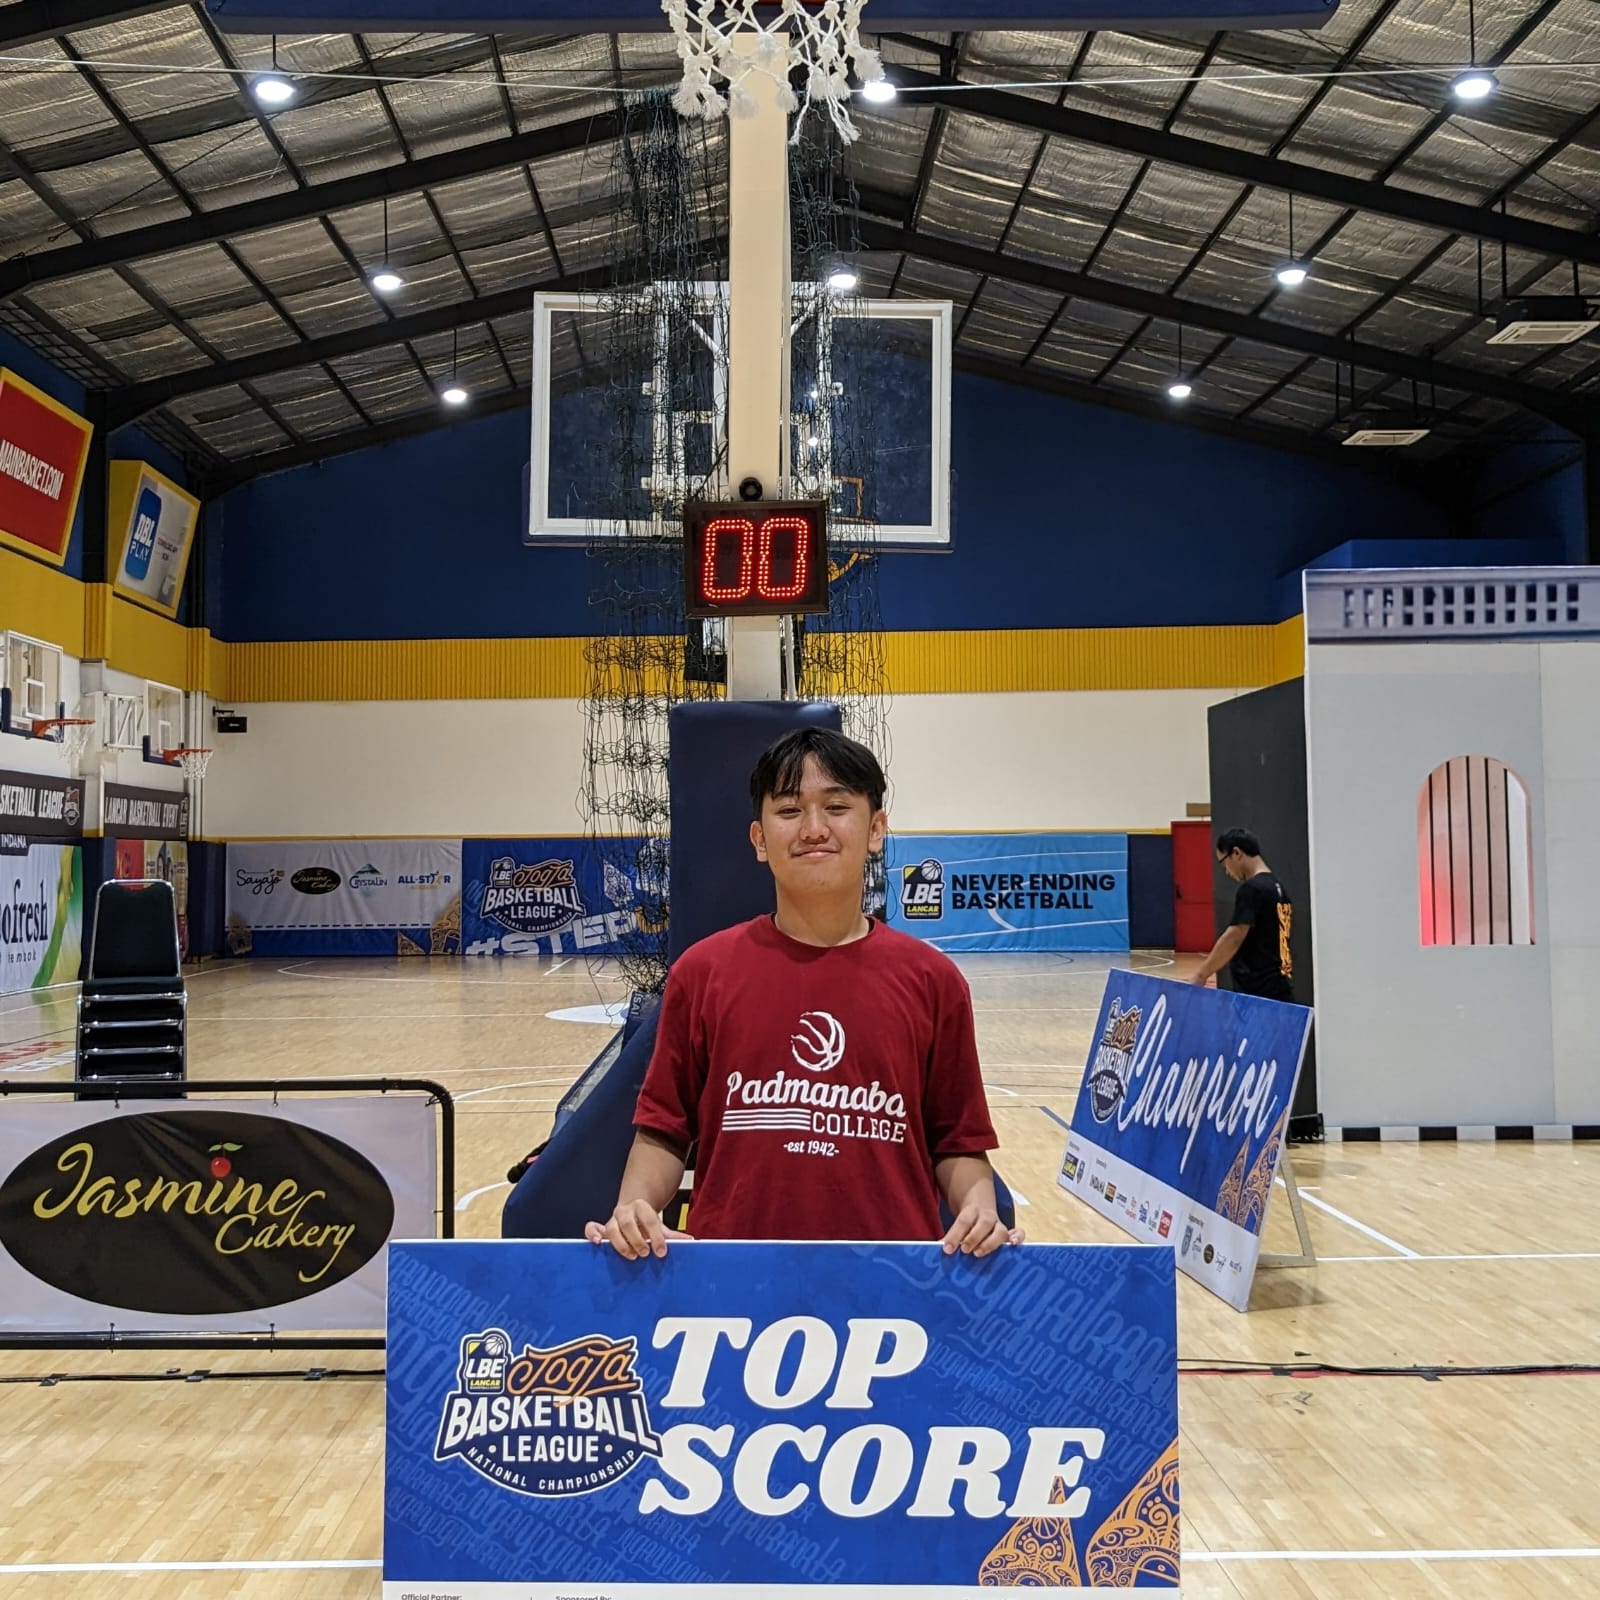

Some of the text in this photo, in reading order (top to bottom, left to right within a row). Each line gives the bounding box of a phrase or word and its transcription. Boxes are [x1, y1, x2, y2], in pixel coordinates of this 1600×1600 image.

[133, 513, 155, 547] DBL
[703, 516, 808, 599] 00
[38, 788, 65, 819] LEAGUE
[494, 870, 512, 880] LBE
[952, 873, 1115, 891] NEVER ENDING
[484, 887, 584, 913] BASKETBALL
[902, 883, 943, 904] LBE
[907, 905, 940, 913] LANCAR
[952, 892, 1094, 909] BASKETBALL
[0, 878, 48, 944] ofresh
[511, 905, 556, 919] LEAGUE
[727, 1071, 906, 1117] Padmanaba
[1118, 994, 1278, 1174] Champion
[813, 1112, 907, 1143] COLLEGE
[33, 1142, 303, 1219] Jasmine
[215, 1190, 356, 1282] Cakery
[466, 1358, 506, 1378] LBE
[651, 1315, 928, 1410] TOP
[470, 1379, 501, 1387] LANCAR
[443, 1396, 659, 1450] BASKETBALL
[503, 1435, 599, 1462] LEAGUE
[467, 1446, 636, 1490] NATIONAL CHAMPIONSHIP
[638, 1424, 1106, 1517] SCORE
